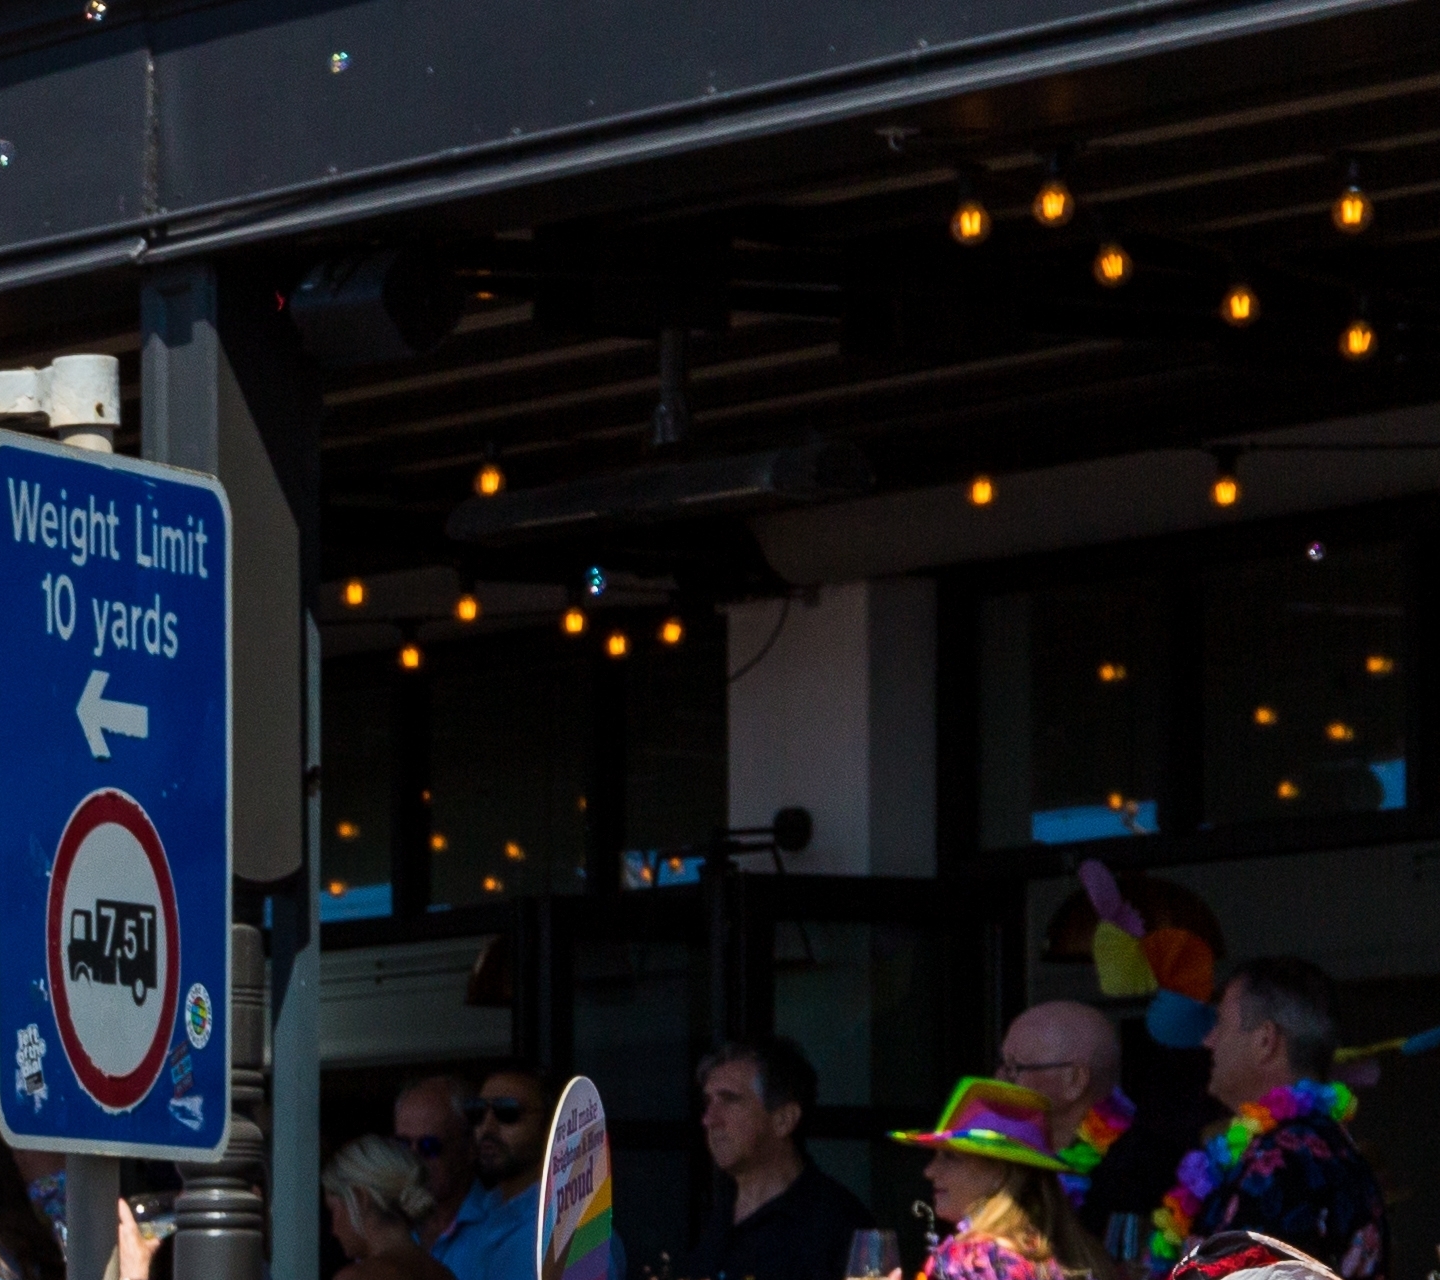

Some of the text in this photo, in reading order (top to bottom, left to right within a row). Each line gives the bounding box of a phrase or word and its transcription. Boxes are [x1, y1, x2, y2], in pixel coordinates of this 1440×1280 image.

[8, 477, 209, 579] Weight Limit
[42, 572, 178, 659] 10 yards
[556, 1155, 594, 1226] proud
